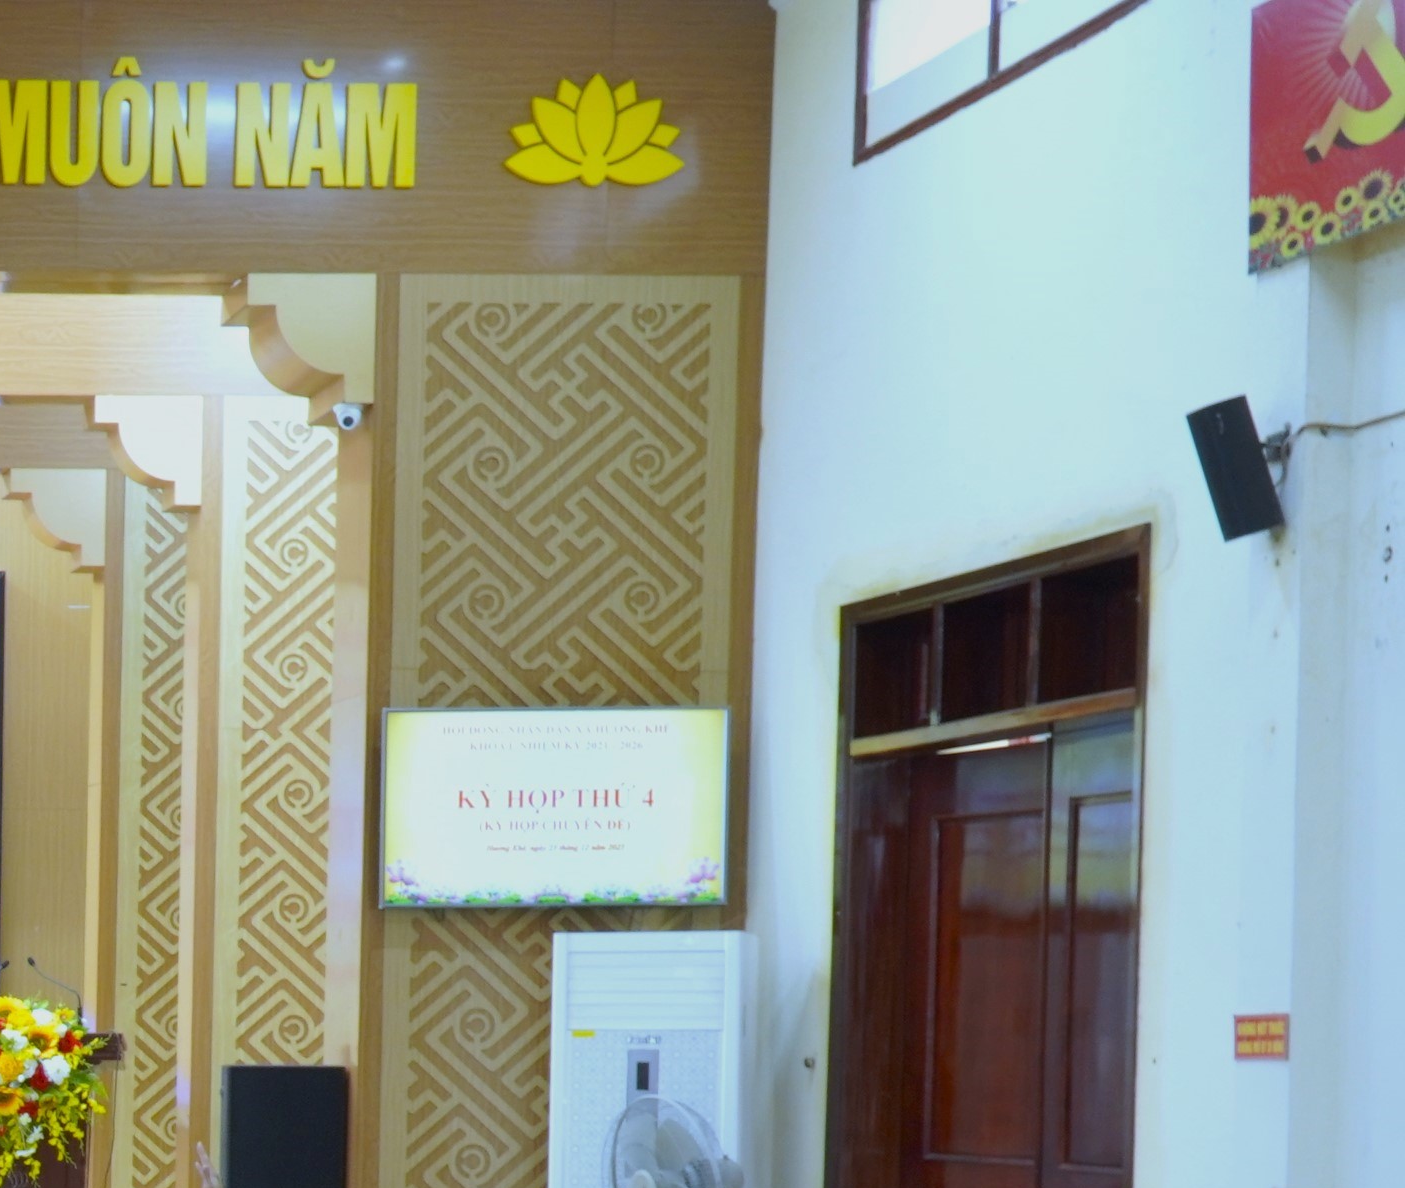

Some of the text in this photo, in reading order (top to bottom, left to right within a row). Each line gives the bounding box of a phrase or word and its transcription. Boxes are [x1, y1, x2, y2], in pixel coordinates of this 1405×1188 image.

[235, 58, 418, 190] NĂM
[507, 788, 566, 815] HỌP
[641, 788, 655, 808] 4
